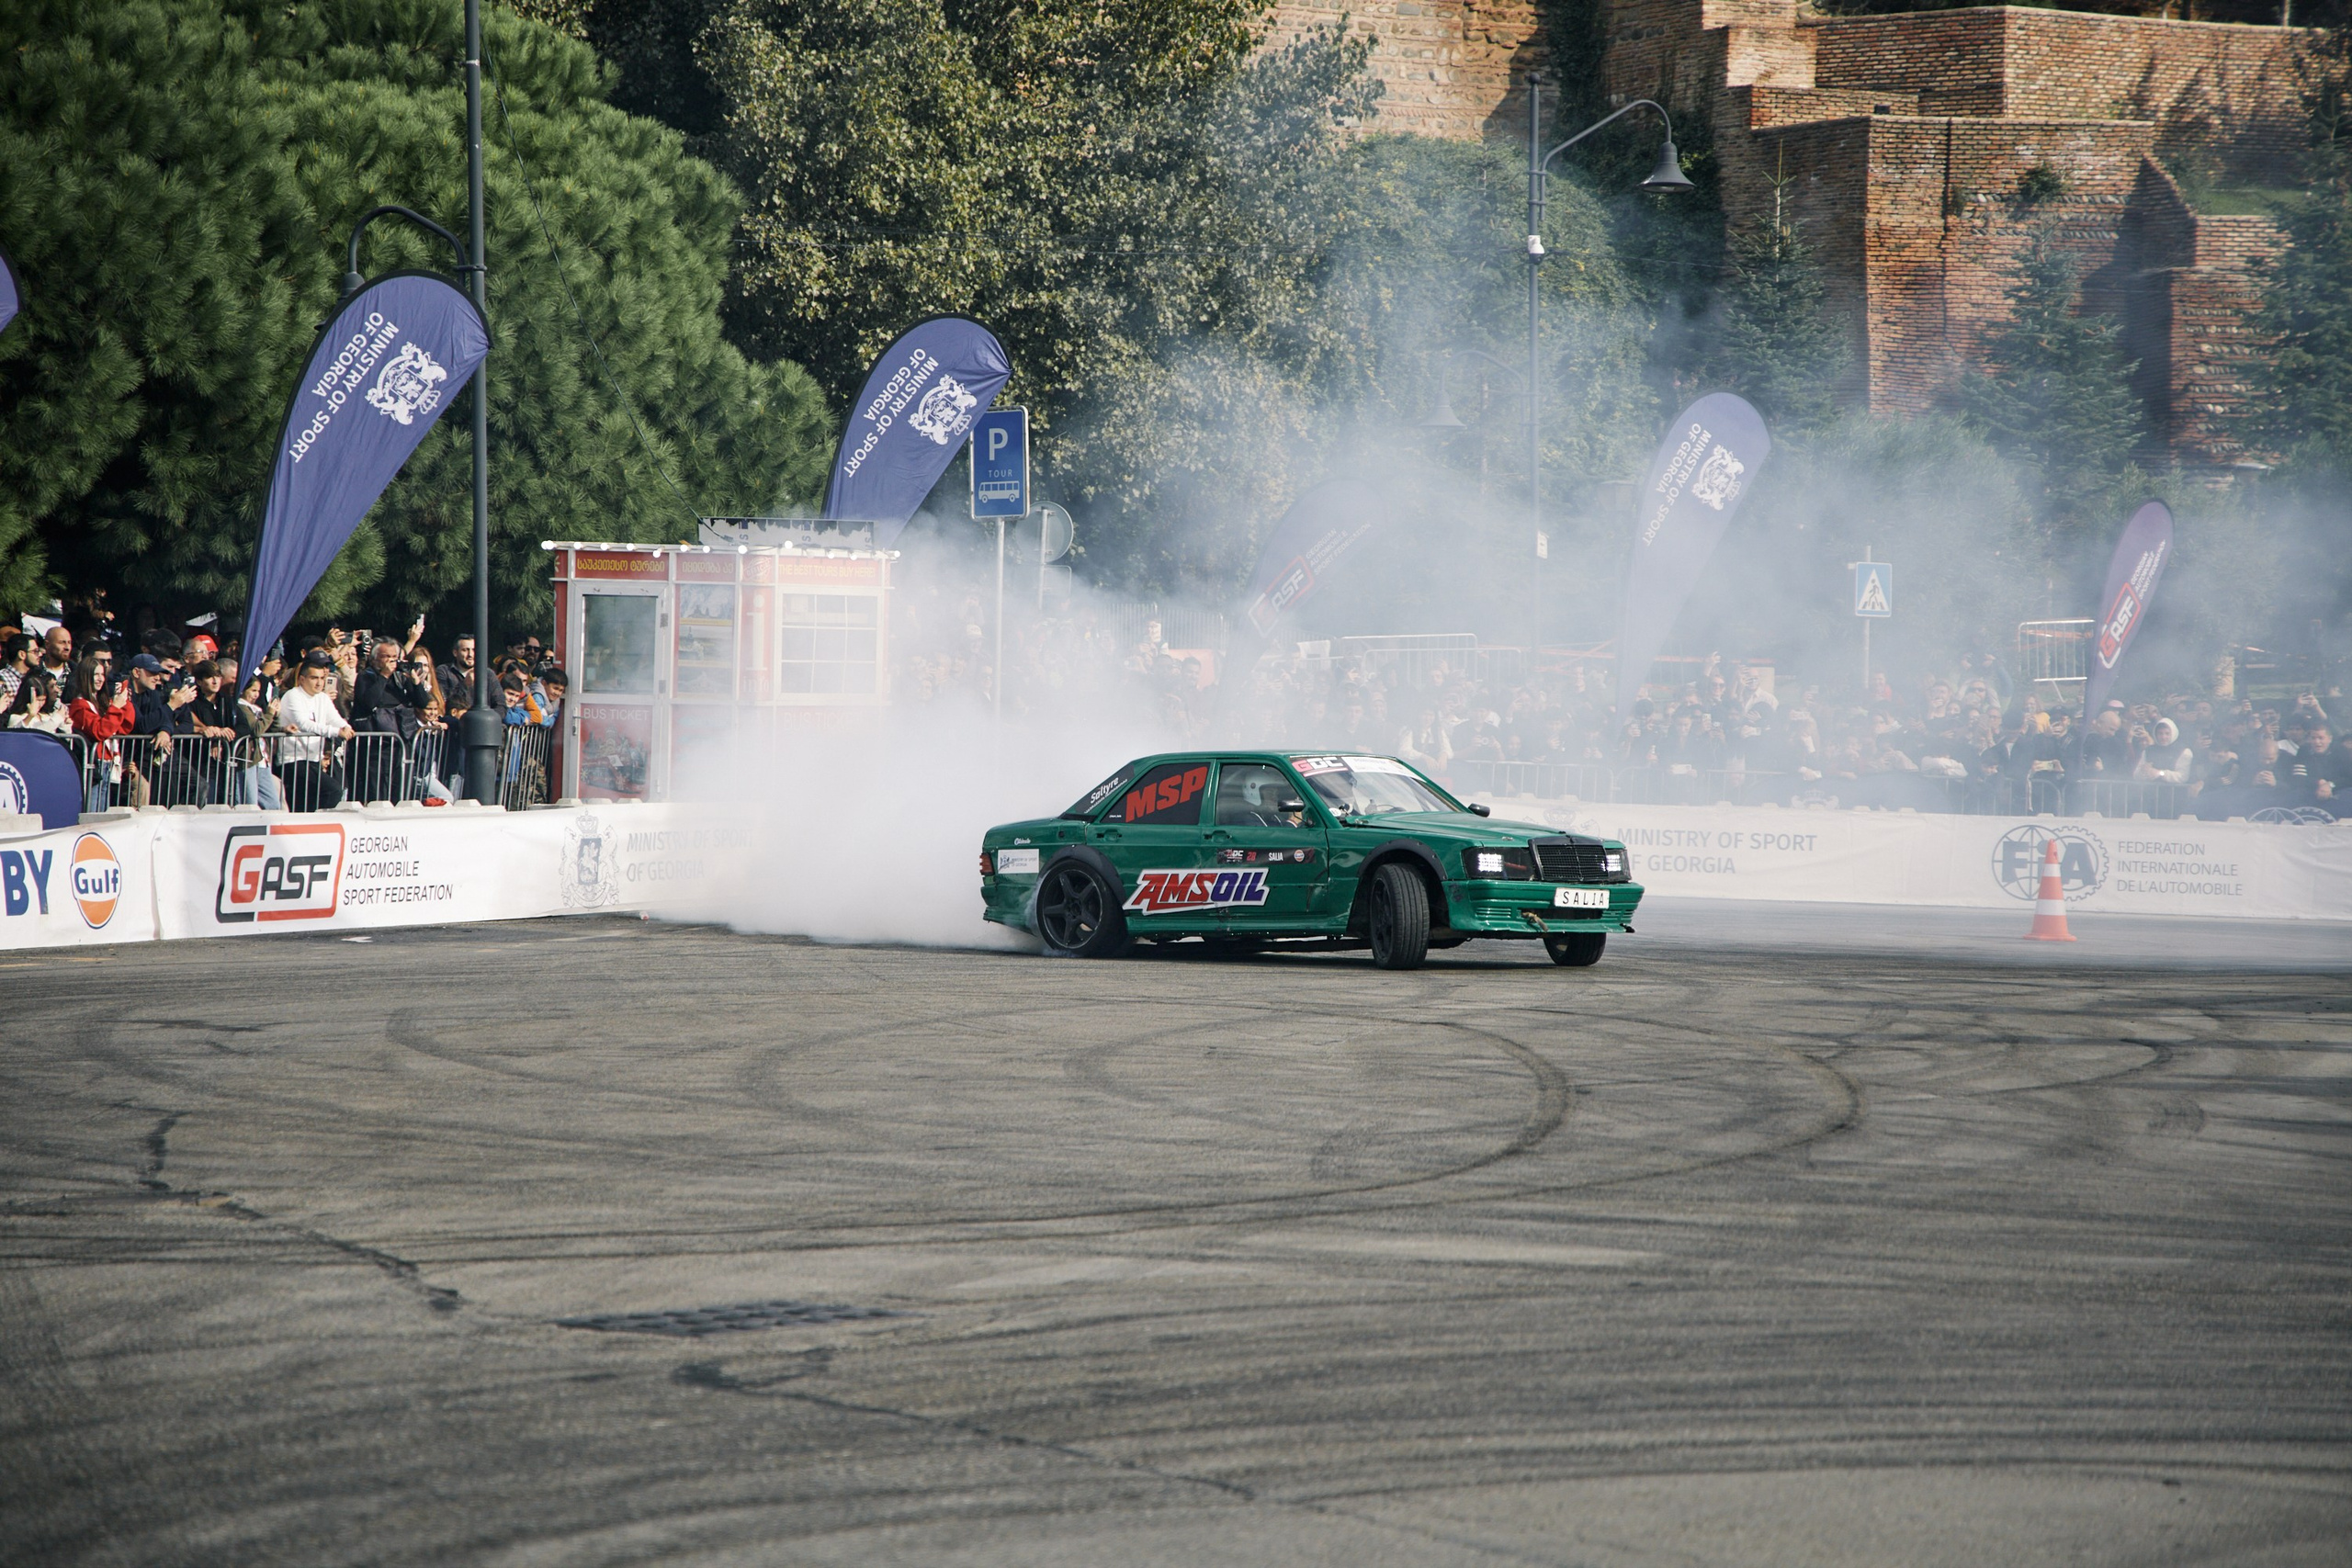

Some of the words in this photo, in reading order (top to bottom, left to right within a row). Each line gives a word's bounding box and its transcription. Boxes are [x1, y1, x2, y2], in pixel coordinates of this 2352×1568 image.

[364, 311, 384, 336] OF
[311, 333, 368, 398] GEORGIA
[342, 321, 400, 393] MINISTRY
[909, 348, 926, 368] OF
[863, 367, 911, 421] GEORGIA
[888, 356, 939, 417] MINISTRY
[326, 389, 347, 414] OF
[288, 411, 331, 463] SPORT
[876, 415, 892, 435] OF
[1688, 423, 1702, 442] OF
[843, 432, 878, 478] SPORT
[989, 428, 1008, 461] P
[1656, 441, 1690, 493] GEORGIA
[1676, 430, 1713, 488] MINISTRY
[988, 468, 1012, 478] TOUR
[1666, 487, 1679, 506] OF
[1642, 503, 1669, 547] SPORT
[1306, 528, 1337, 559] GEORGIAN
[1314, 555, 1334, 576] SPORT
[1333, 523, 1372, 558] FEDERATION
[629, 559, 665, 572] ტურები
[778, 564, 793, 575] THE
[794, 565, 813, 576] BEST
[814, 565, 839, 577] TOURS
[840, 566, 854, 578] BUY
[2099, 595, 2134, 658] GASF
[583, 707, 606, 720] BUS
[609, 708, 650, 721] TICKET
[1292, 756, 1344, 773] GDC
[1091, 777, 1119, 804] Saltyre
[1125, 766, 1208, 823] MSP
[350, 836, 409, 853] GEORGIAN
[627, 831, 688, 853] MINISTRY
[694, 830, 711, 849] OF
[714, 829, 753, 848] SPORT
[1616, 828, 1712, 848] MINISTRY
[1717, 831, 1744, 849] OF
[1750, 832, 1817, 852] SPORT
[2118, 840, 2206, 856] FEDERATION
[1246, 852, 1257, 862] 28
[1268, 852, 1283, 862] SALIA
[1647, 854, 1736, 874] GEORGIA
[2117, 860, 2239, 876] INTERNATIONALE
[74, 867, 119, 895] Gulf
[230, 844, 333, 904] GASF
[345, 861, 420, 880] AUTOMOBILE
[627, 861, 646, 883] OF
[648, 859, 705, 882] GEORGIA
[0, 850, 53, 916] BY
[343, 887, 381, 906] SPORT
[383, 884, 454, 903] FEDERATION
[1131, 873, 1266, 912] AMSOIL
[2117, 879, 2135, 892] DE
[1562, 891, 1604, 906] SALIA
